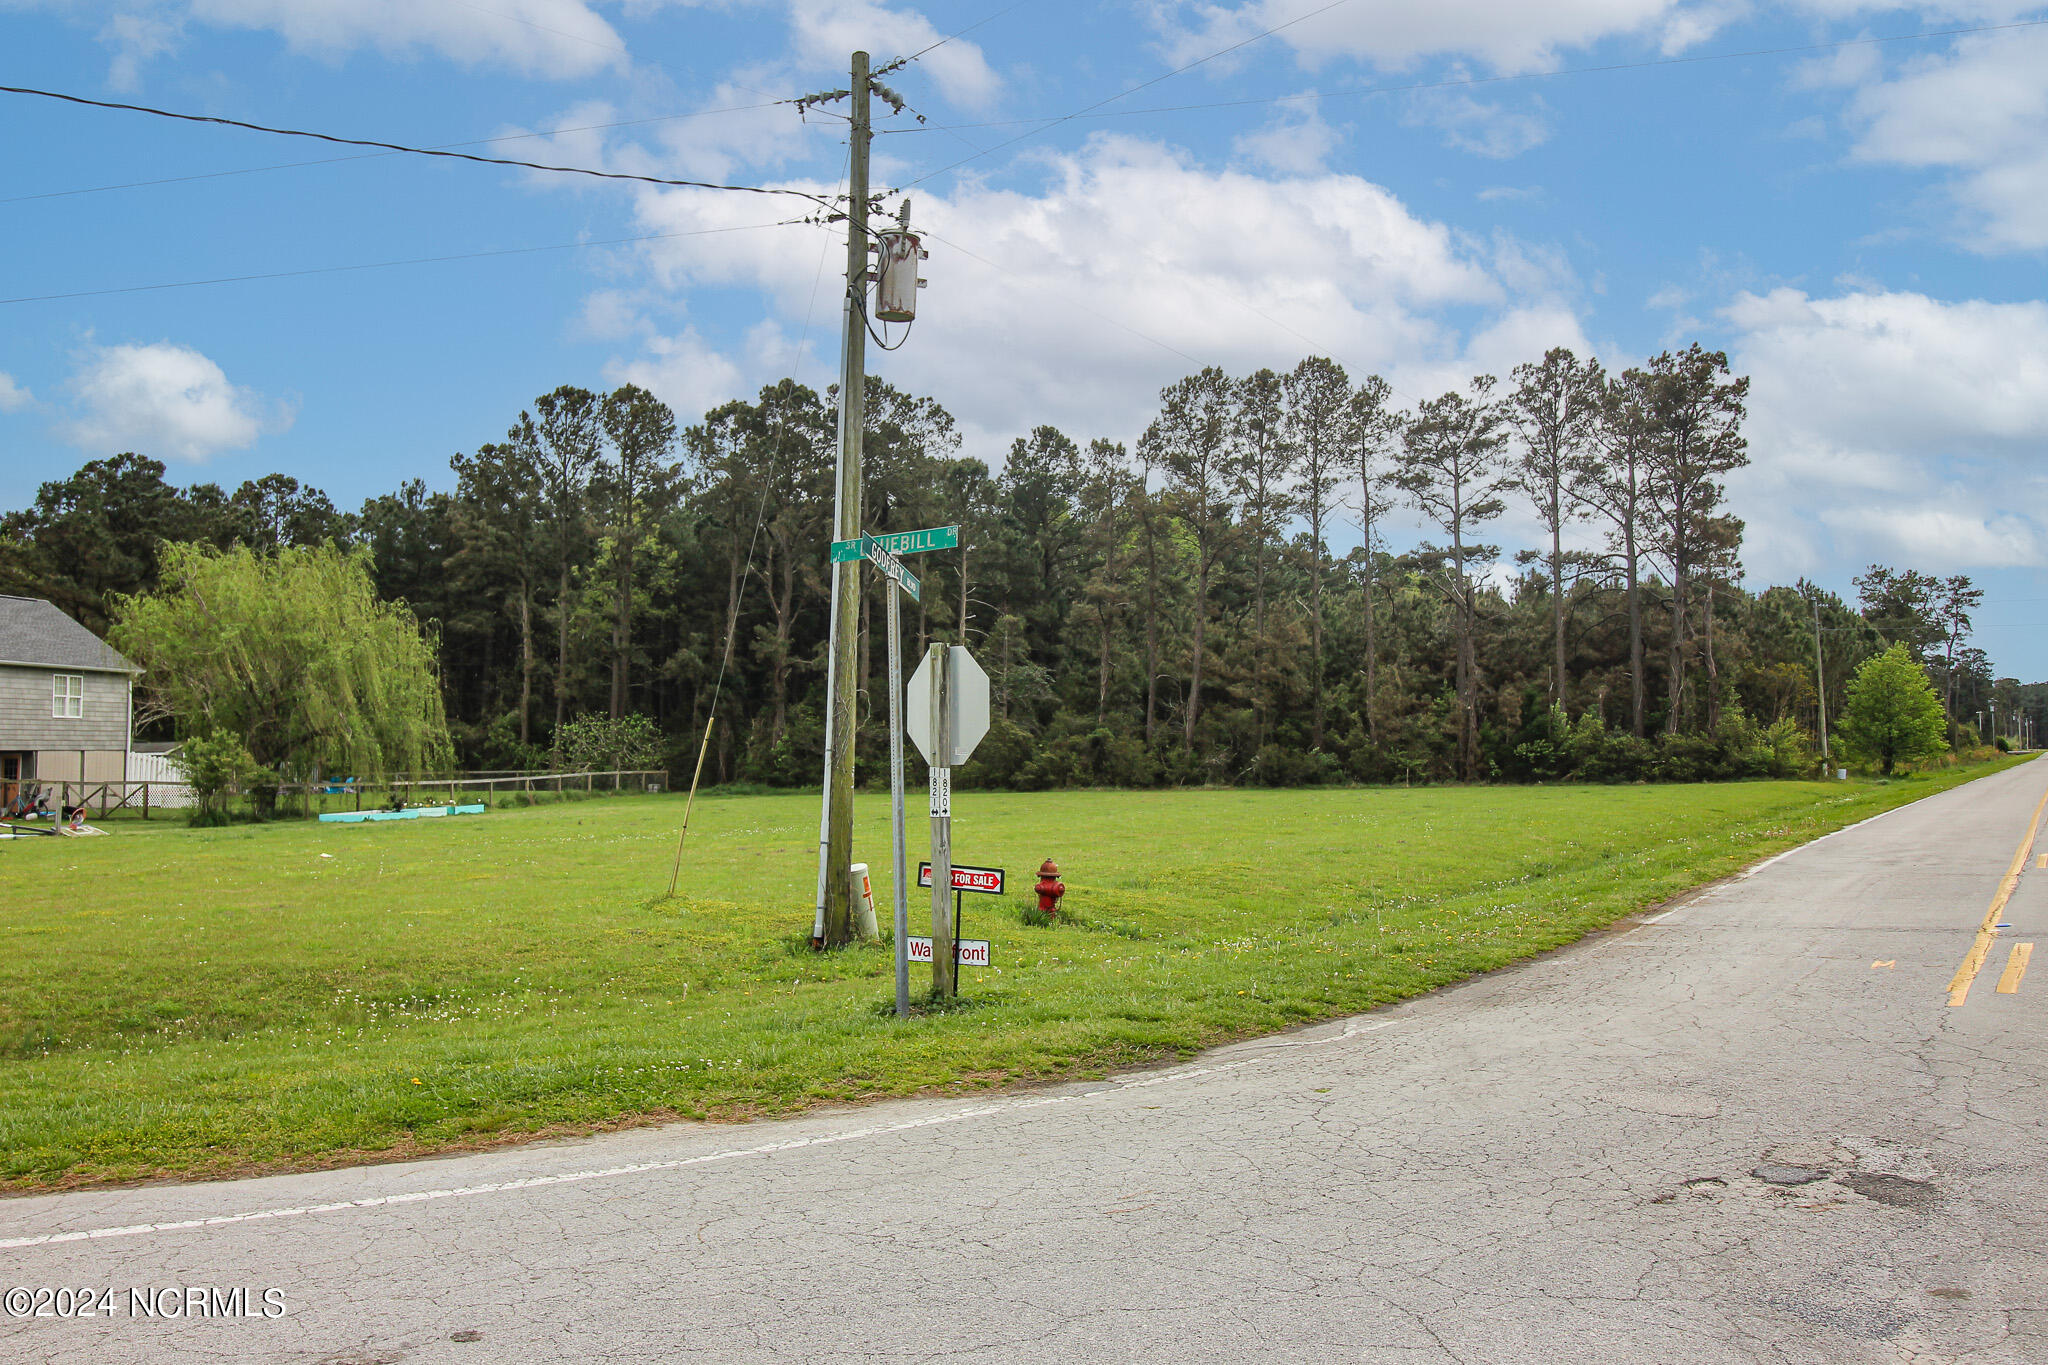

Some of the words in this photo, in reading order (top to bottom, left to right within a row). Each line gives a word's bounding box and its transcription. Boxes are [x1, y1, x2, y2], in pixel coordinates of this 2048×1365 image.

[845, 541, 856, 550] SR
[860, 532, 936, 557] UEBILL
[947, 527, 958, 536] DR
[871, 542, 905, 583] GODFREY
[906, 577, 916, 592] BLVD
[954, 873, 971, 885] FOR
[972, 874, 994, 887] SALE
[910, 941, 986, 961] Wafont
